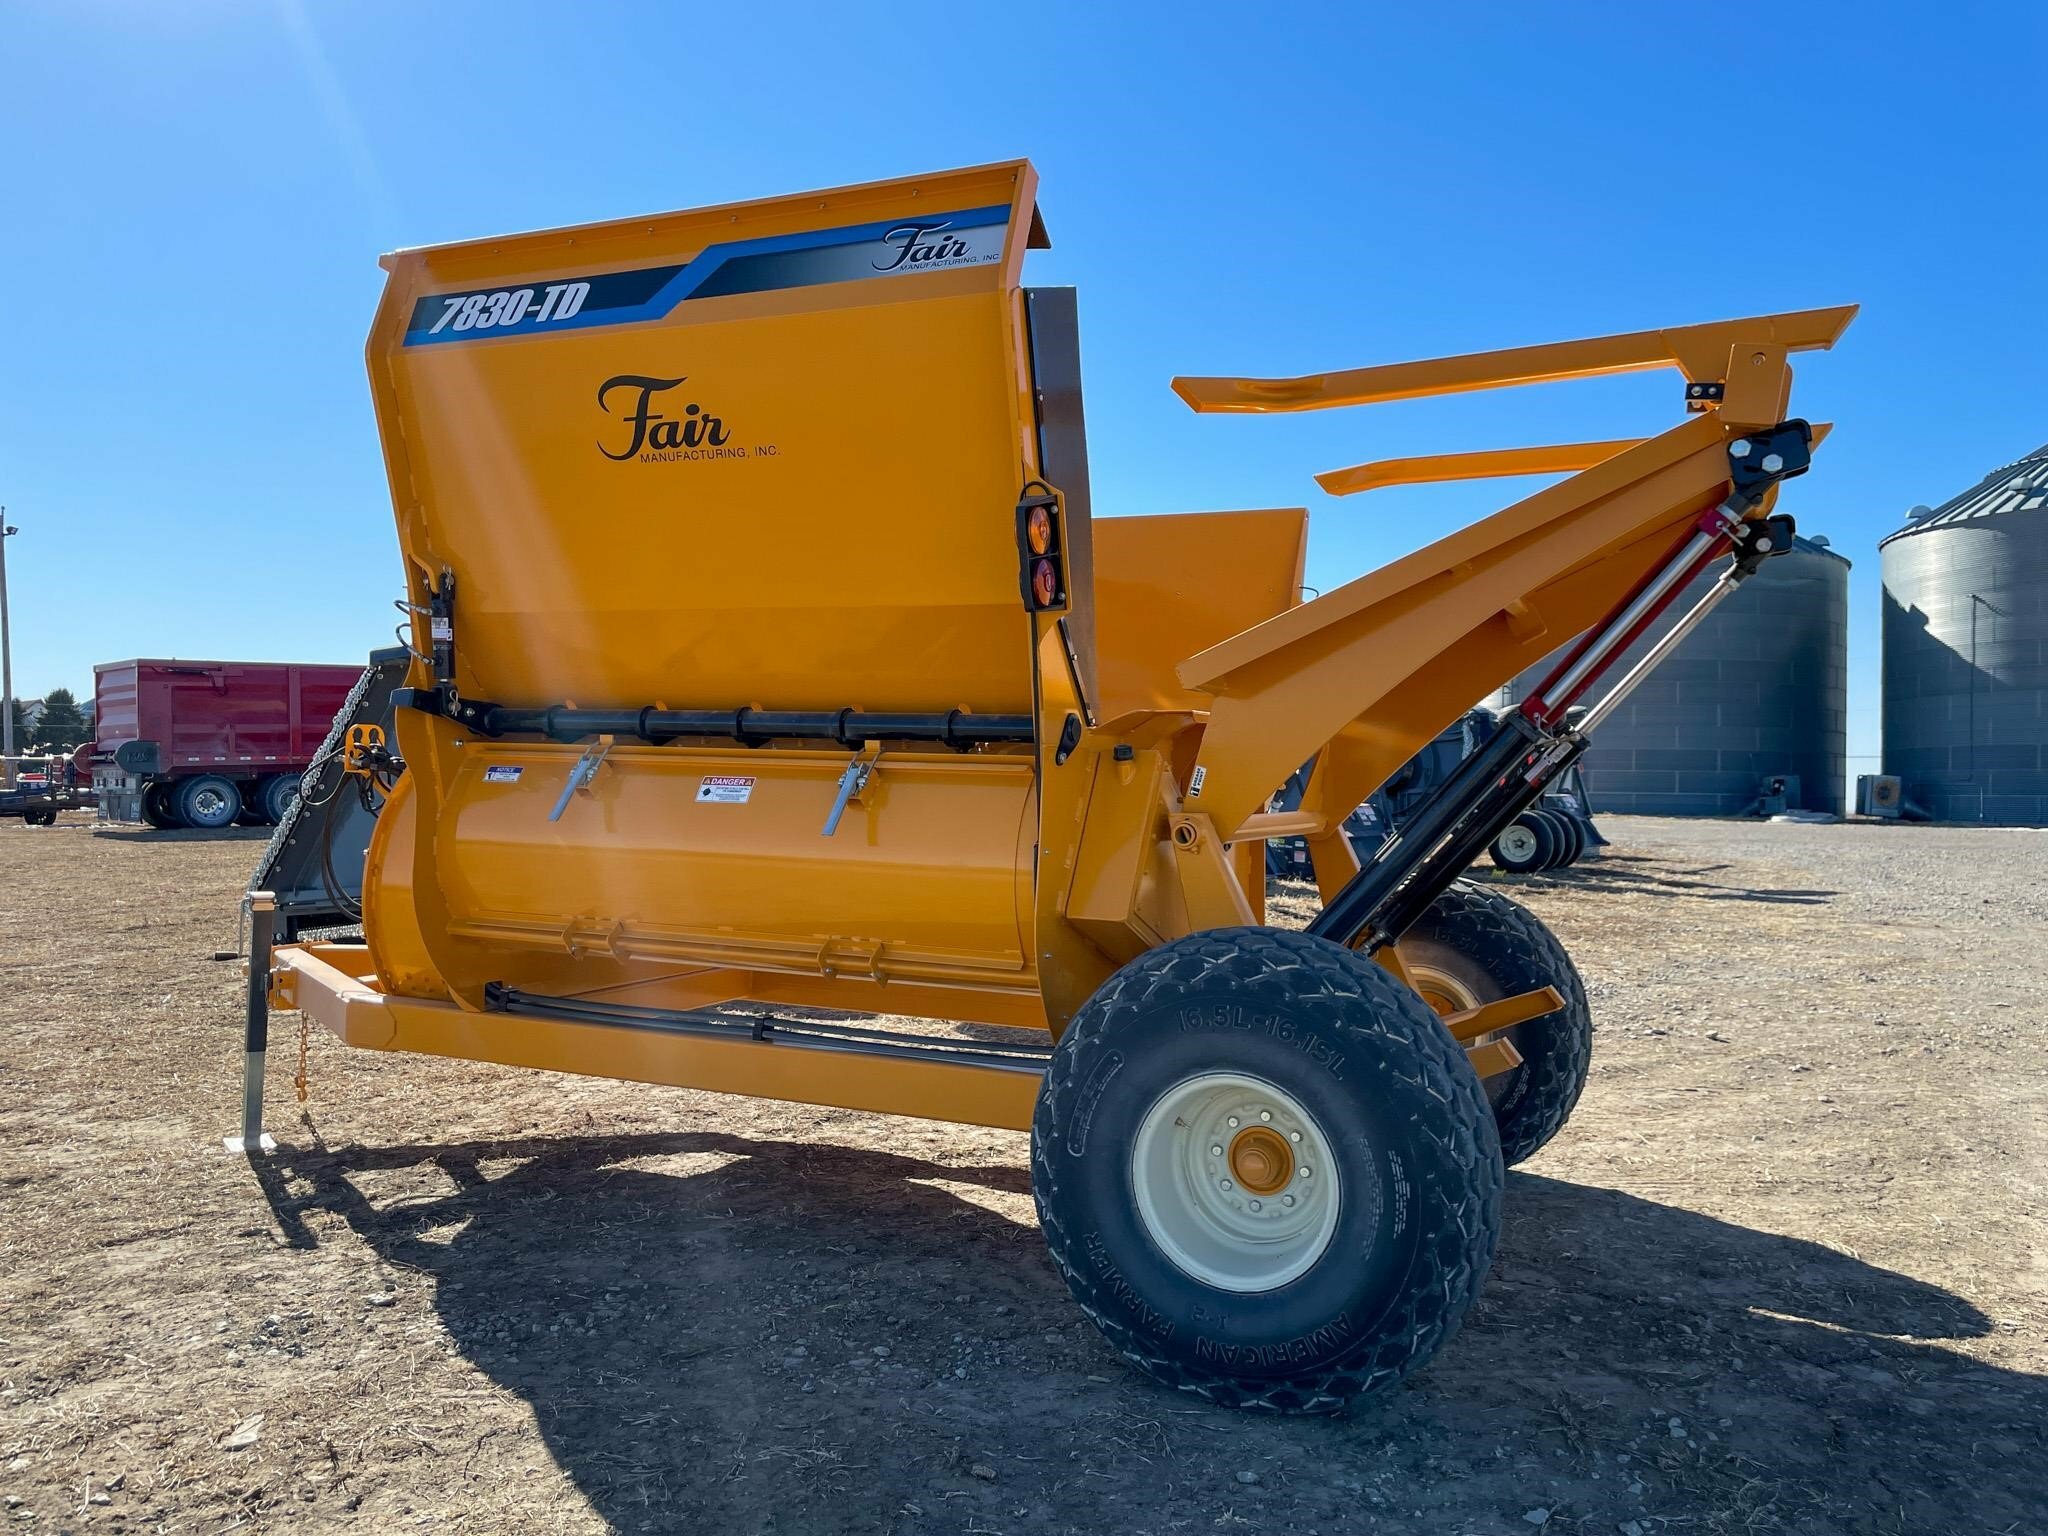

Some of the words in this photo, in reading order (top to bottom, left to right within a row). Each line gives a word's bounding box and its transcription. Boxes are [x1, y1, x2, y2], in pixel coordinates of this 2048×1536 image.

[871, 220, 971, 271] Fair
[900, 256, 979, 272] MANUFACTURING,
[428, 281, 590, 335] 7830-TD
[597, 374, 730, 461] Fair
[640, 447, 751, 464] MANUFACTURING,
[755, 445, 781, 457] INC.
[1082, 1231, 1175, 1341] FARMER
[1195, 1311, 1353, 1370] AMERICAN
